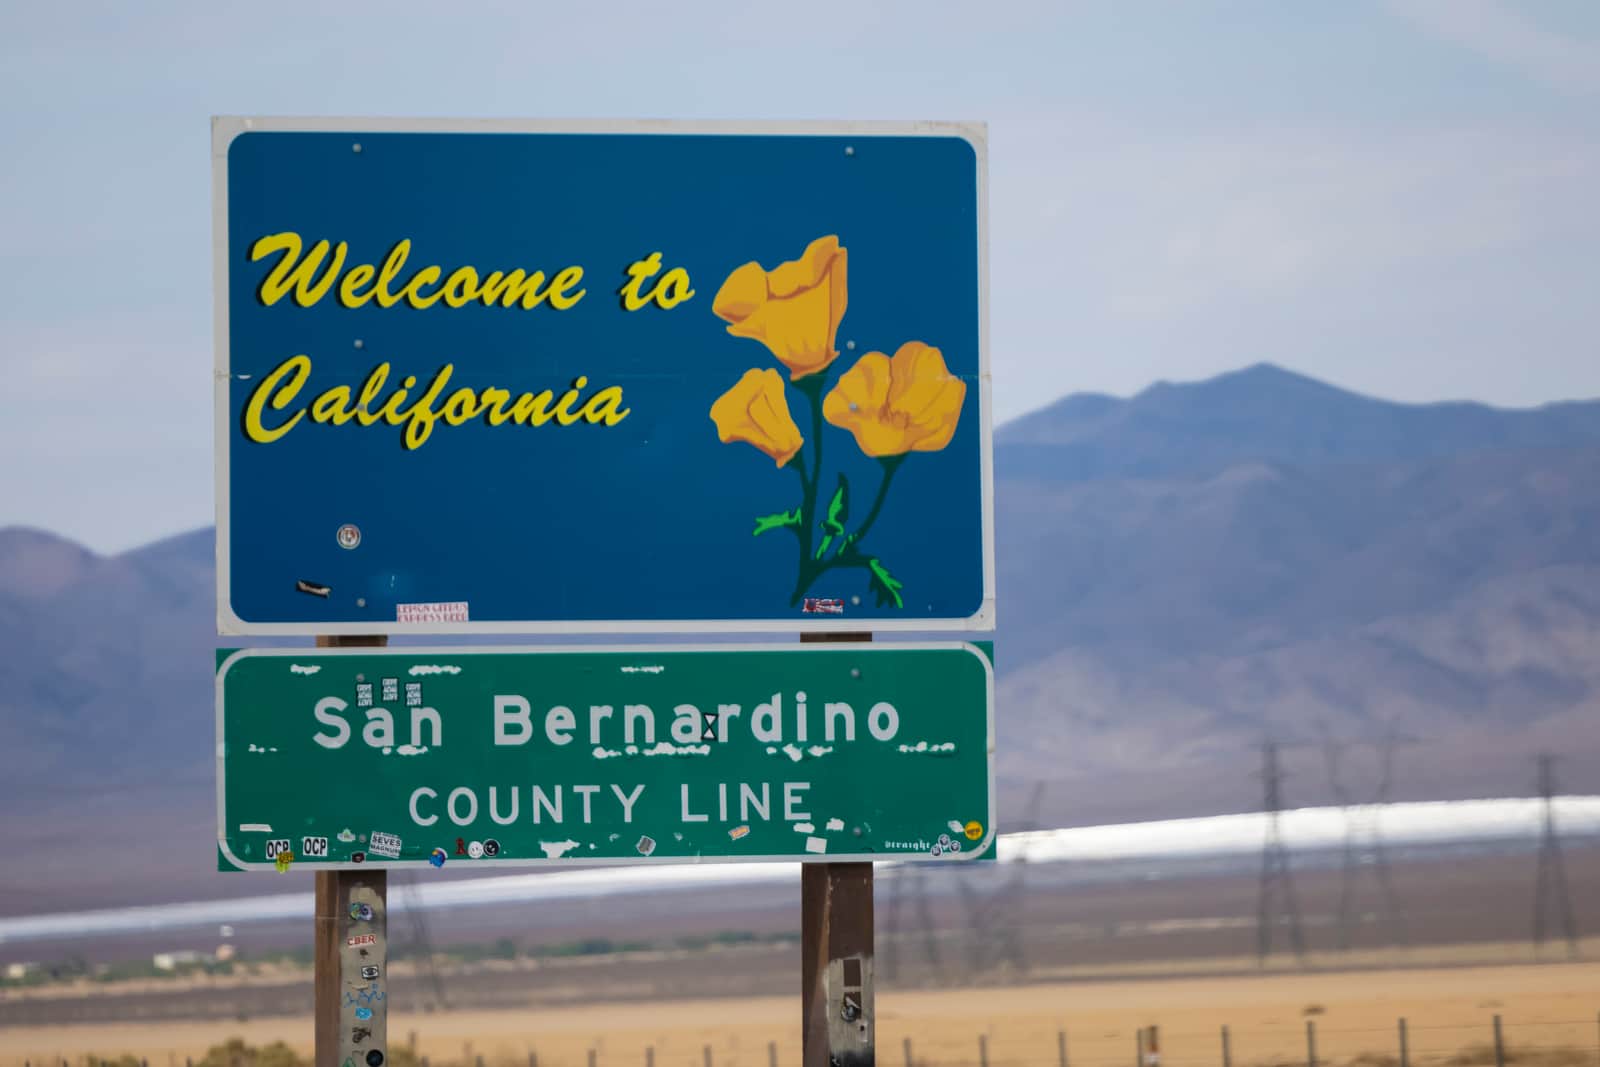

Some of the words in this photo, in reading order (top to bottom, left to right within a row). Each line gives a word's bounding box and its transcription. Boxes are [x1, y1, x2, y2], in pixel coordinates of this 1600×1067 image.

[250, 232, 585, 310] Welcome
[620, 252, 695, 311] to
[244, 354, 630, 450] California
[312, 696, 442, 749] San
[494, 691, 900, 746] Bernardino
[408, 784, 646, 826] COUNTY
[681, 781, 812, 822] LINE
[304, 838, 327, 855] OCP
